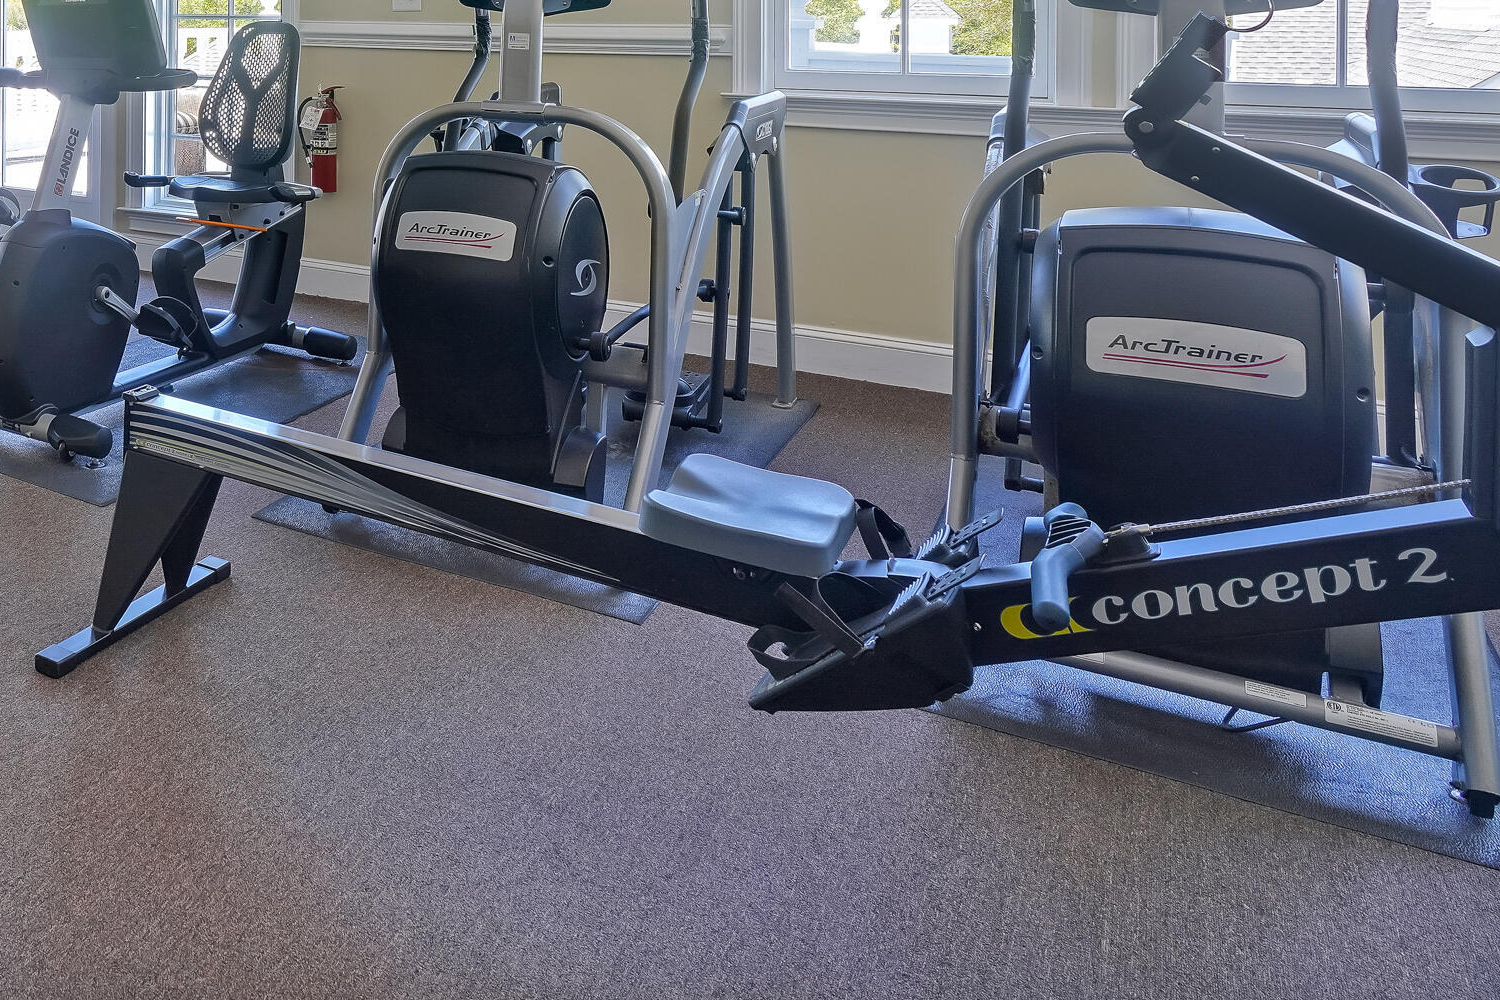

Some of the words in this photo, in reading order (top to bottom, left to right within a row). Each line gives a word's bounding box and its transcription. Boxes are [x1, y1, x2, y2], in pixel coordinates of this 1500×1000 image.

[56, 127, 80, 185] LANDICE
[408, 222, 492, 239] ArcTrainer
[1107, 334, 1263, 364] ArcTrainer
[146, 441, 171, 452] concept
[1091, 557, 1387, 625] concept
[1397, 547, 1448, 584] 2
